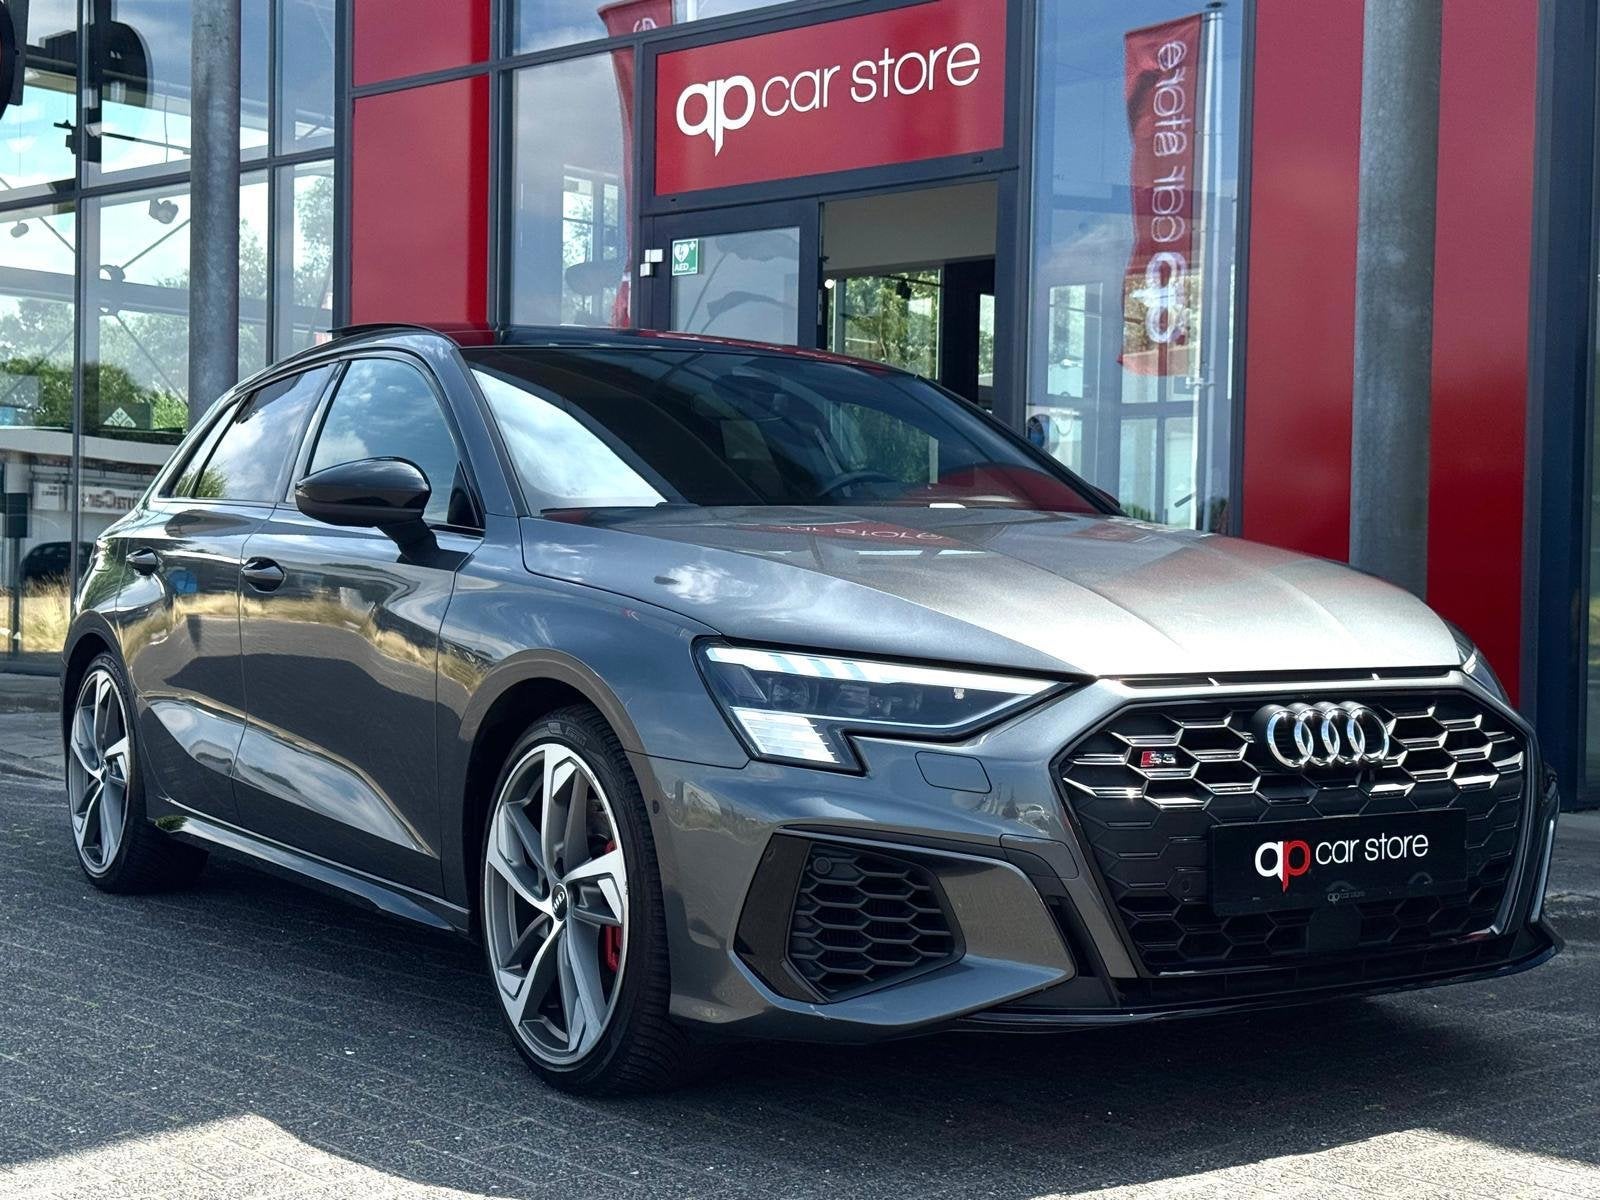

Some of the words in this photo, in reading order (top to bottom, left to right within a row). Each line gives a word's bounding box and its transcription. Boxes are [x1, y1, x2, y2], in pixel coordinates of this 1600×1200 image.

[762, 65, 841, 117] car
[850, 42, 981, 103] store
[674, 262, 689, 271] AED
[1146, 752, 1176, 765] S3
[1315, 839, 1359, 865] car
[1364, 833, 1429, 861] store
